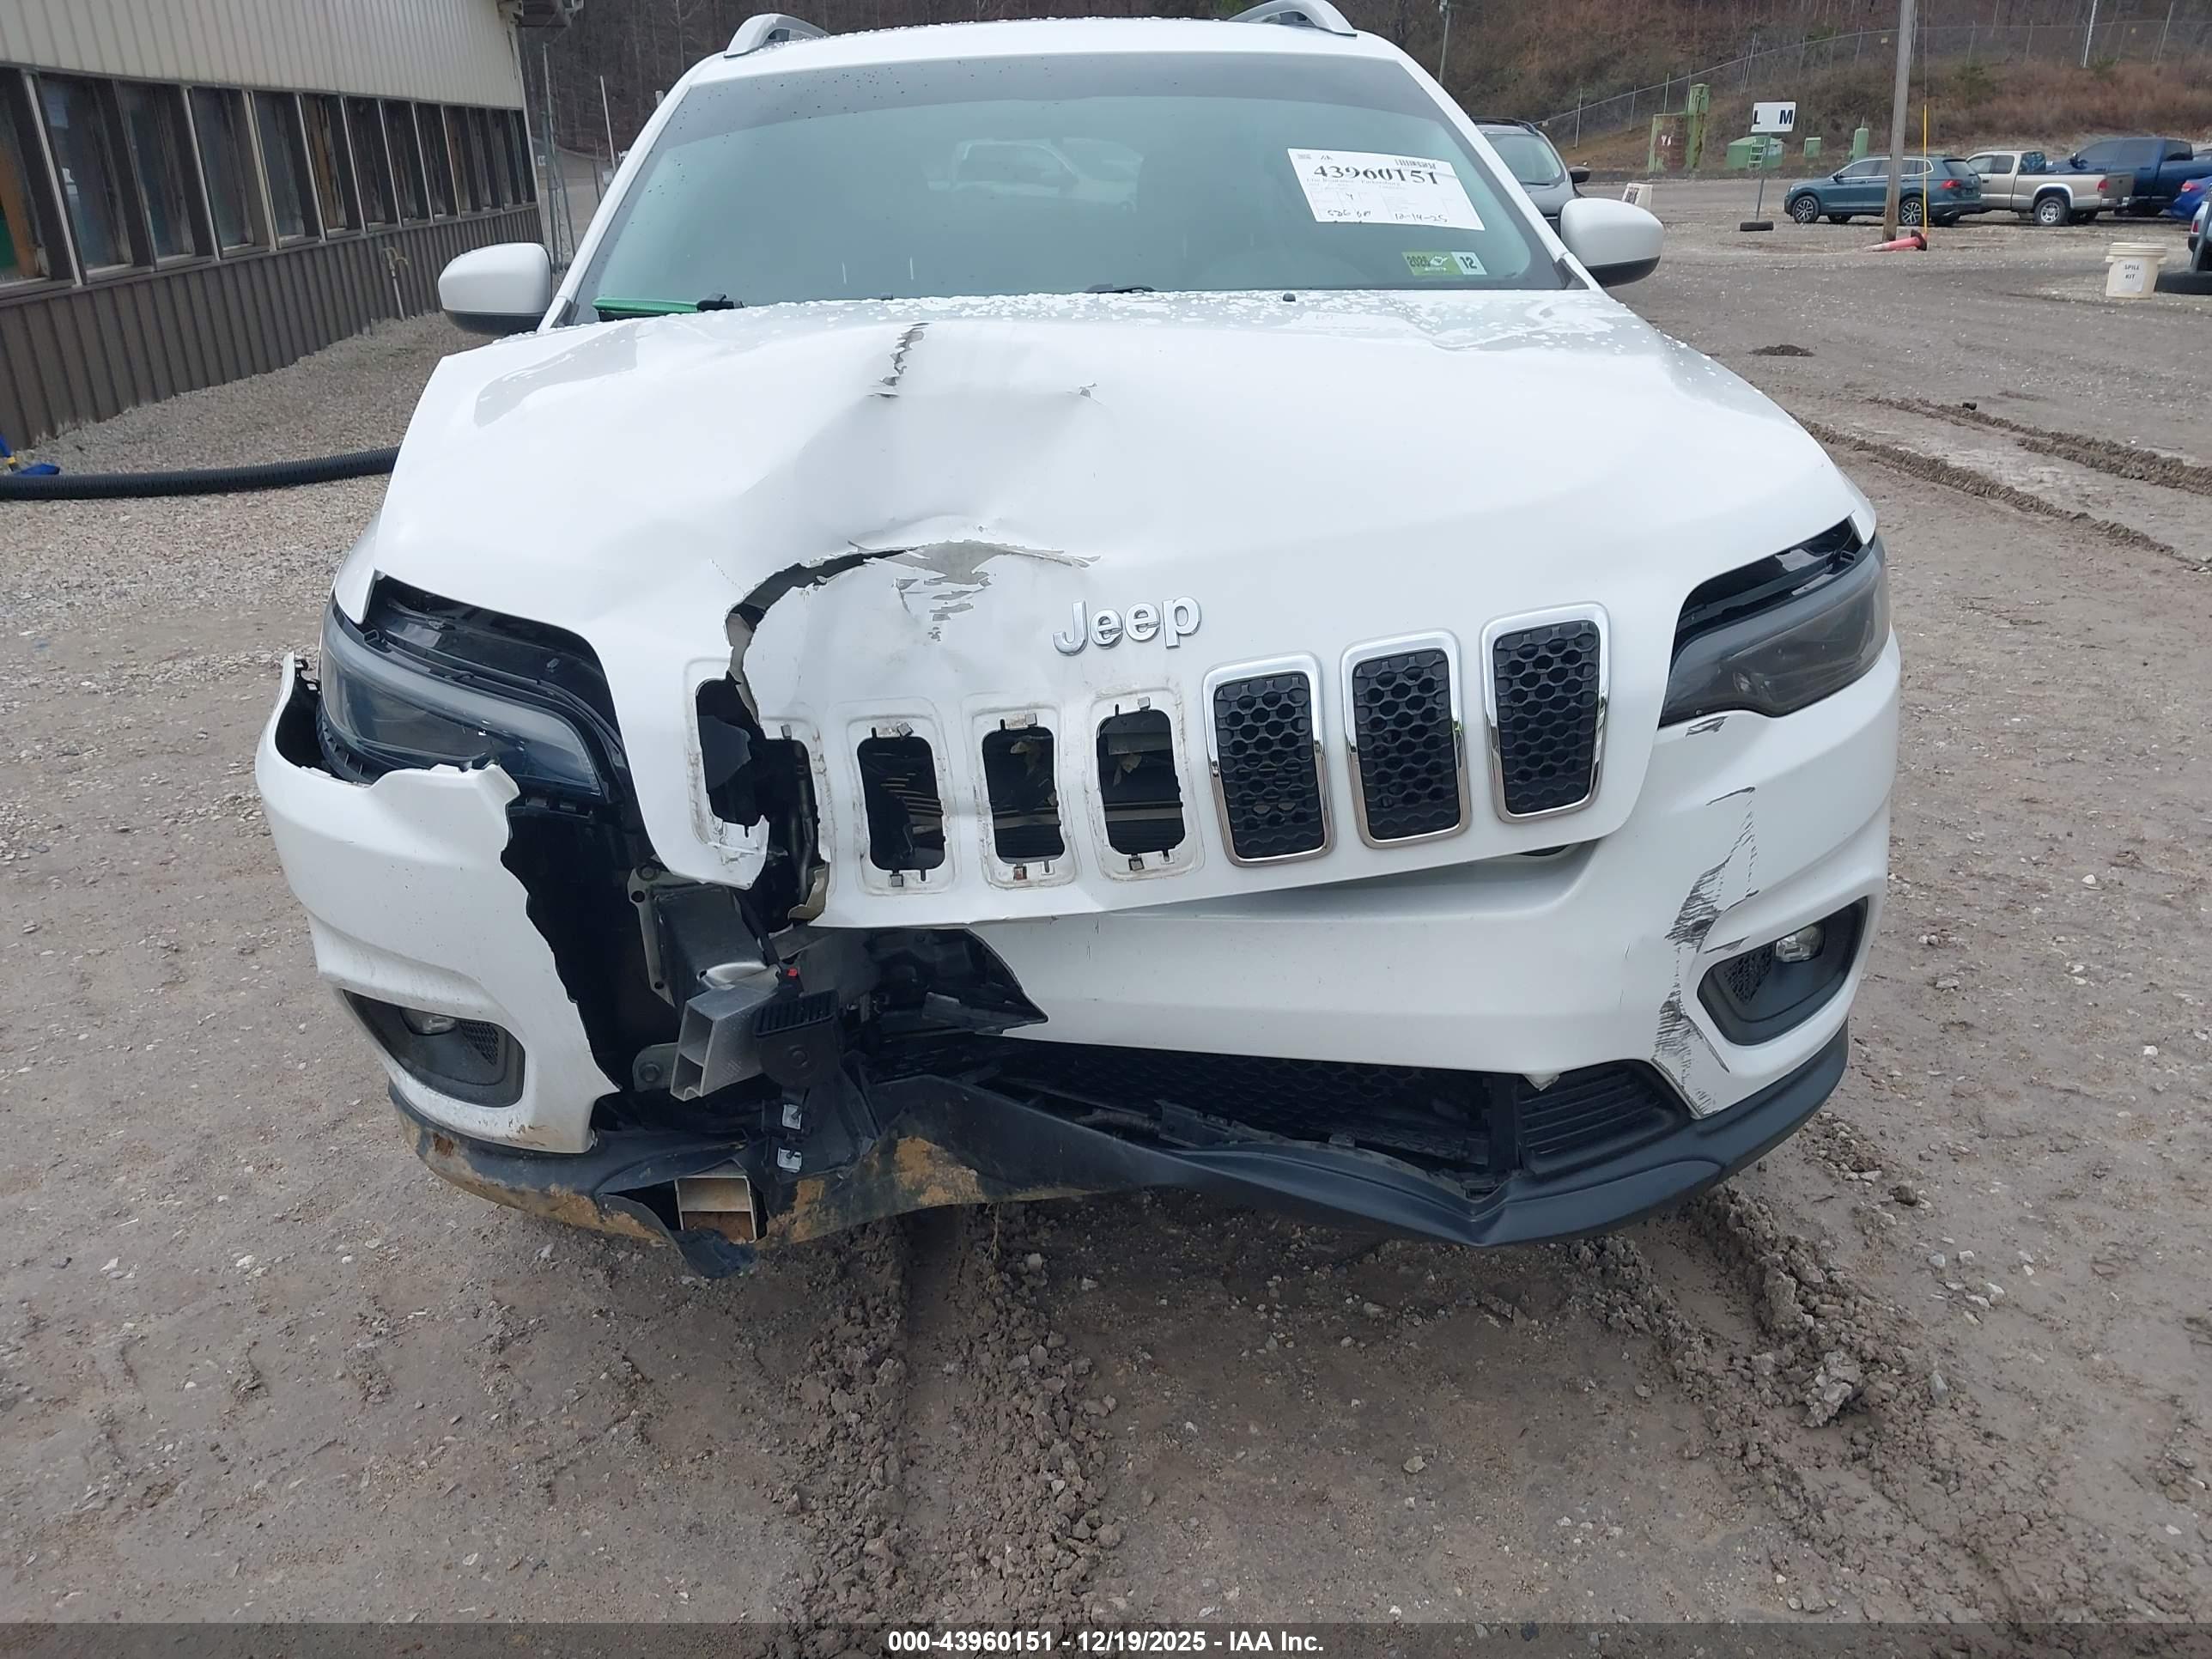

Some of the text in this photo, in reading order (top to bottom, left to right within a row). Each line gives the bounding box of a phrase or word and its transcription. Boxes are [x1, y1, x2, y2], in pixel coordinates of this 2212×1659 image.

[1779, 110, 1794, 125] M
[1313, 165, 1440, 185] 43960151
[1459, 256, 1478, 270] 12
[1053, 595, 1202, 656] Jeep
